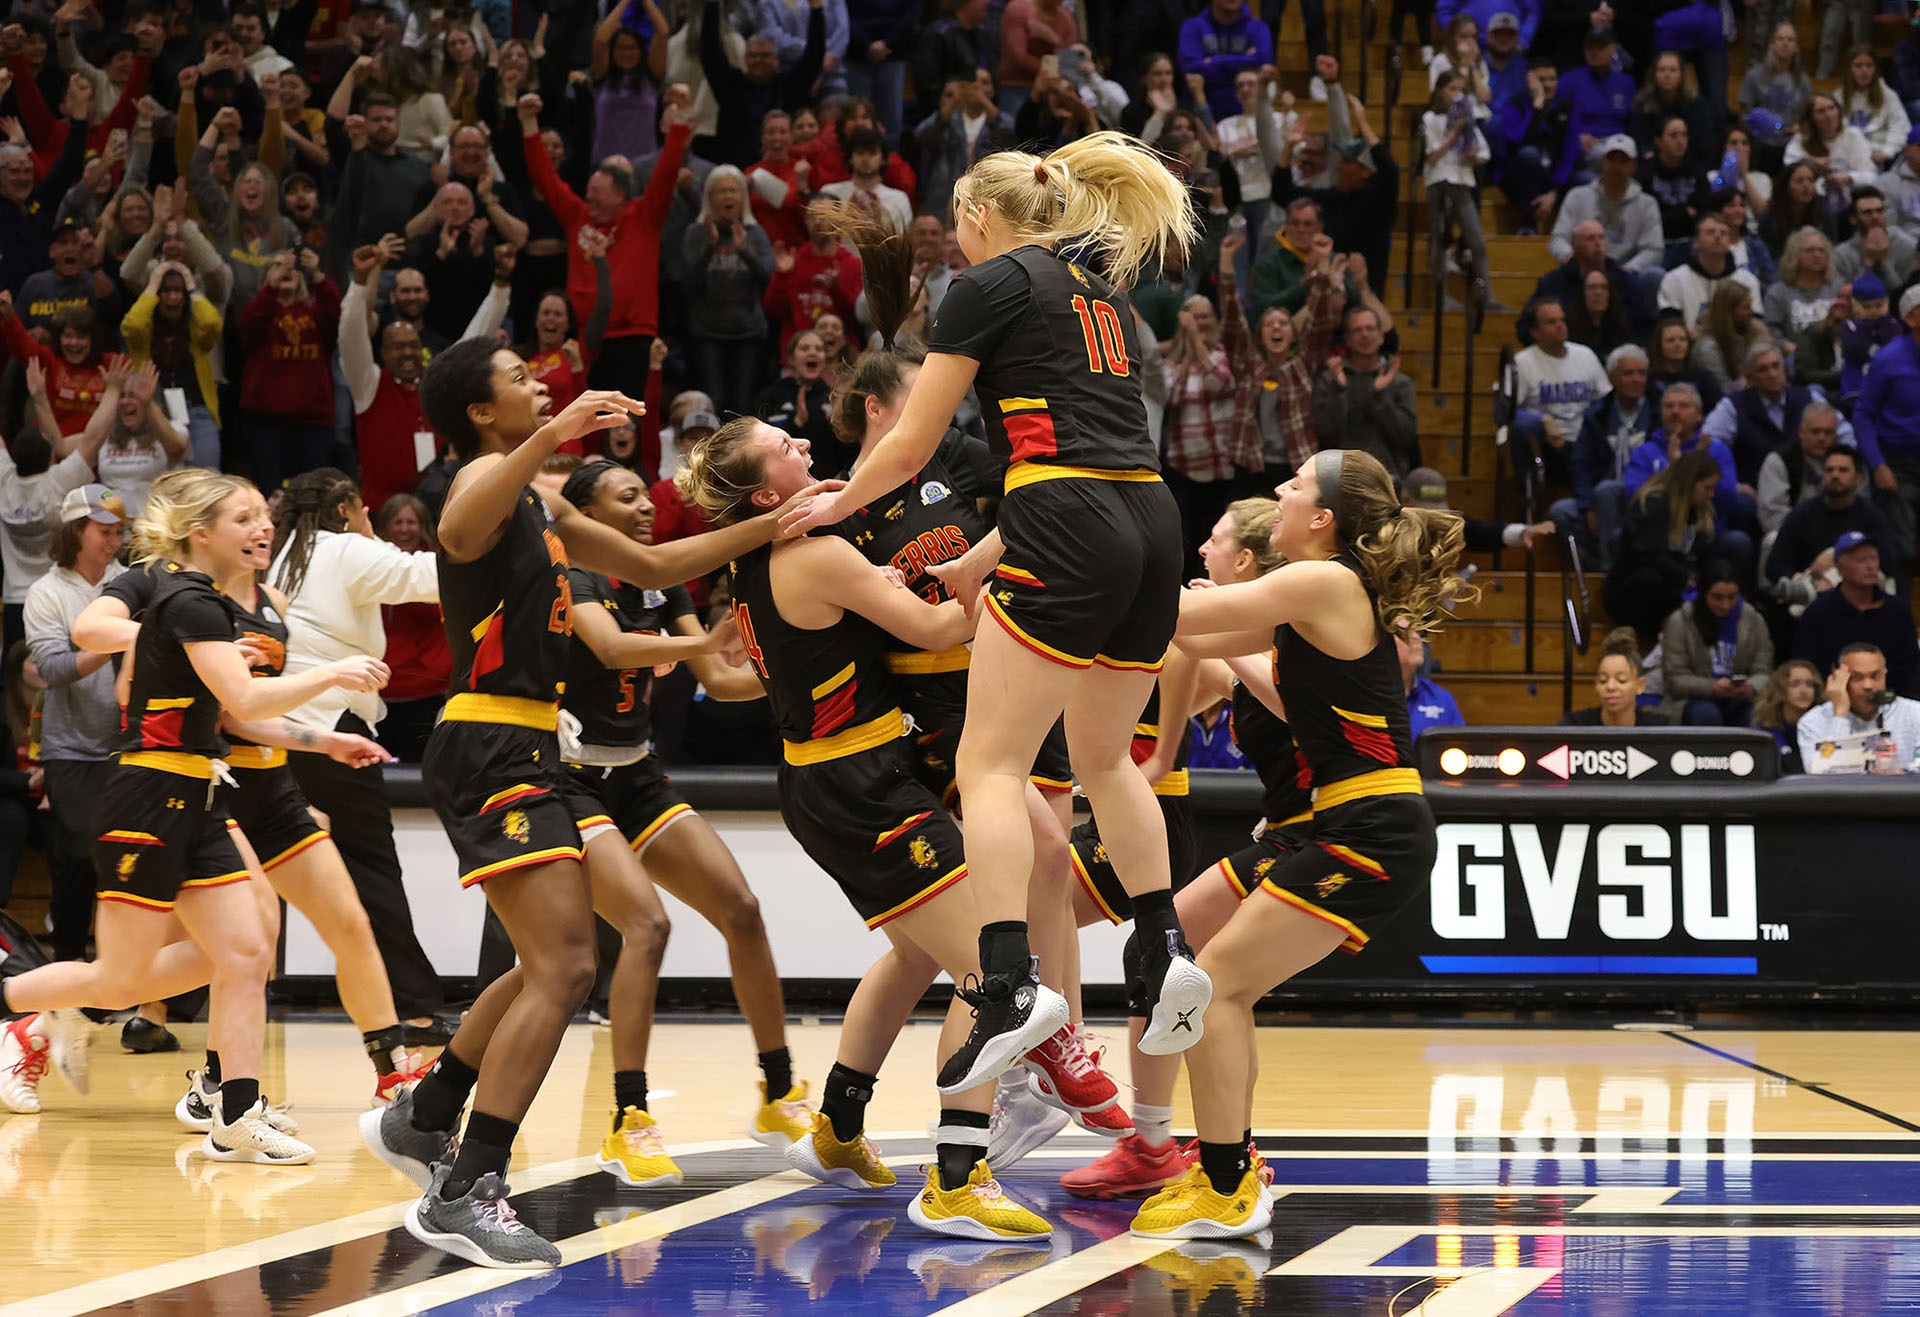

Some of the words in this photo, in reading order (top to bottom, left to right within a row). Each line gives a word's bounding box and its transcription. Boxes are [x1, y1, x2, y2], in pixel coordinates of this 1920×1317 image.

[1070, 293, 1130, 378] 10
[887, 524, 971, 588] ERRIS
[616, 669, 639, 713] 5
[1467, 754, 1500, 769] BONUS
[1569, 749, 1628, 776] POSS
[1695, 755, 1730, 770] BONUS
[1429, 822, 1759, 941] GVSU
[1759, 923, 1790, 942] TM
